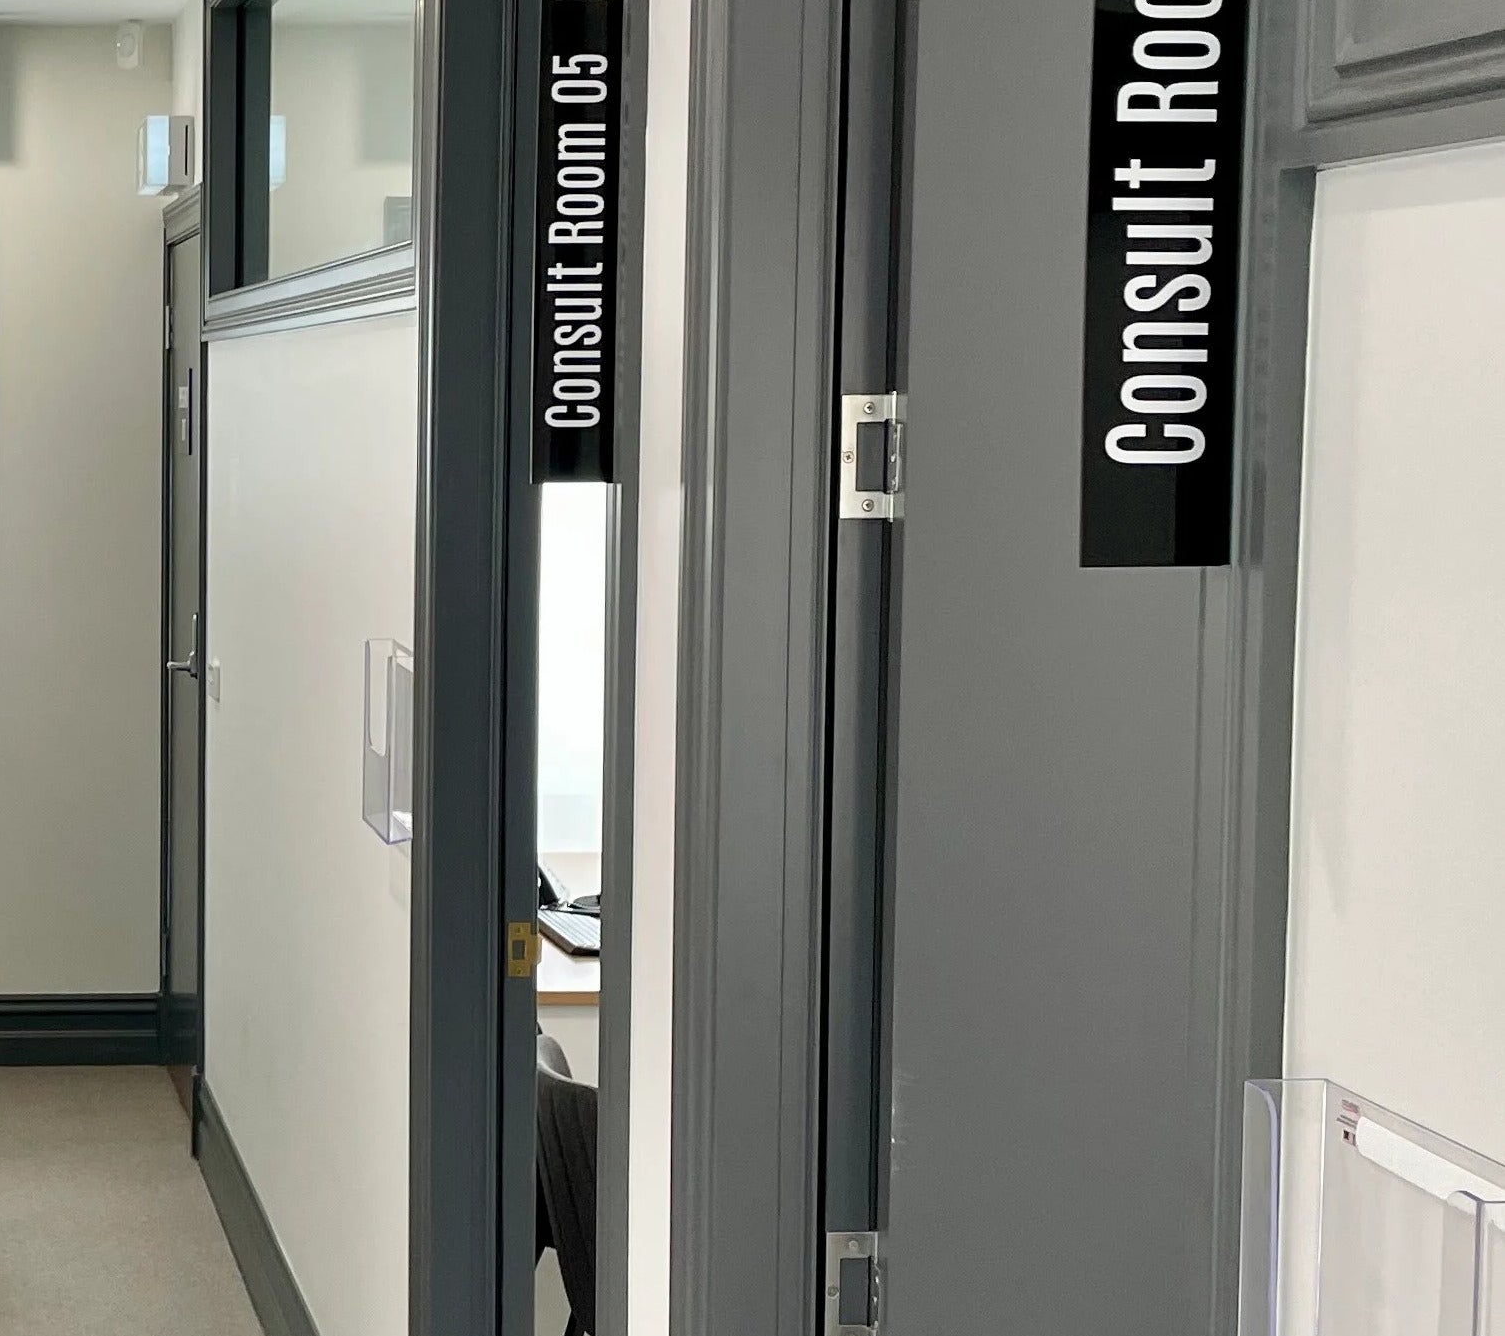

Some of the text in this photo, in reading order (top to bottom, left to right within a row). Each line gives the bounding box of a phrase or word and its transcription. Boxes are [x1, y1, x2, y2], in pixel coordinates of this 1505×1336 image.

[545, 54, 608, 429] Consult Room 05
[1105, 159, 1217, 463] Consult
